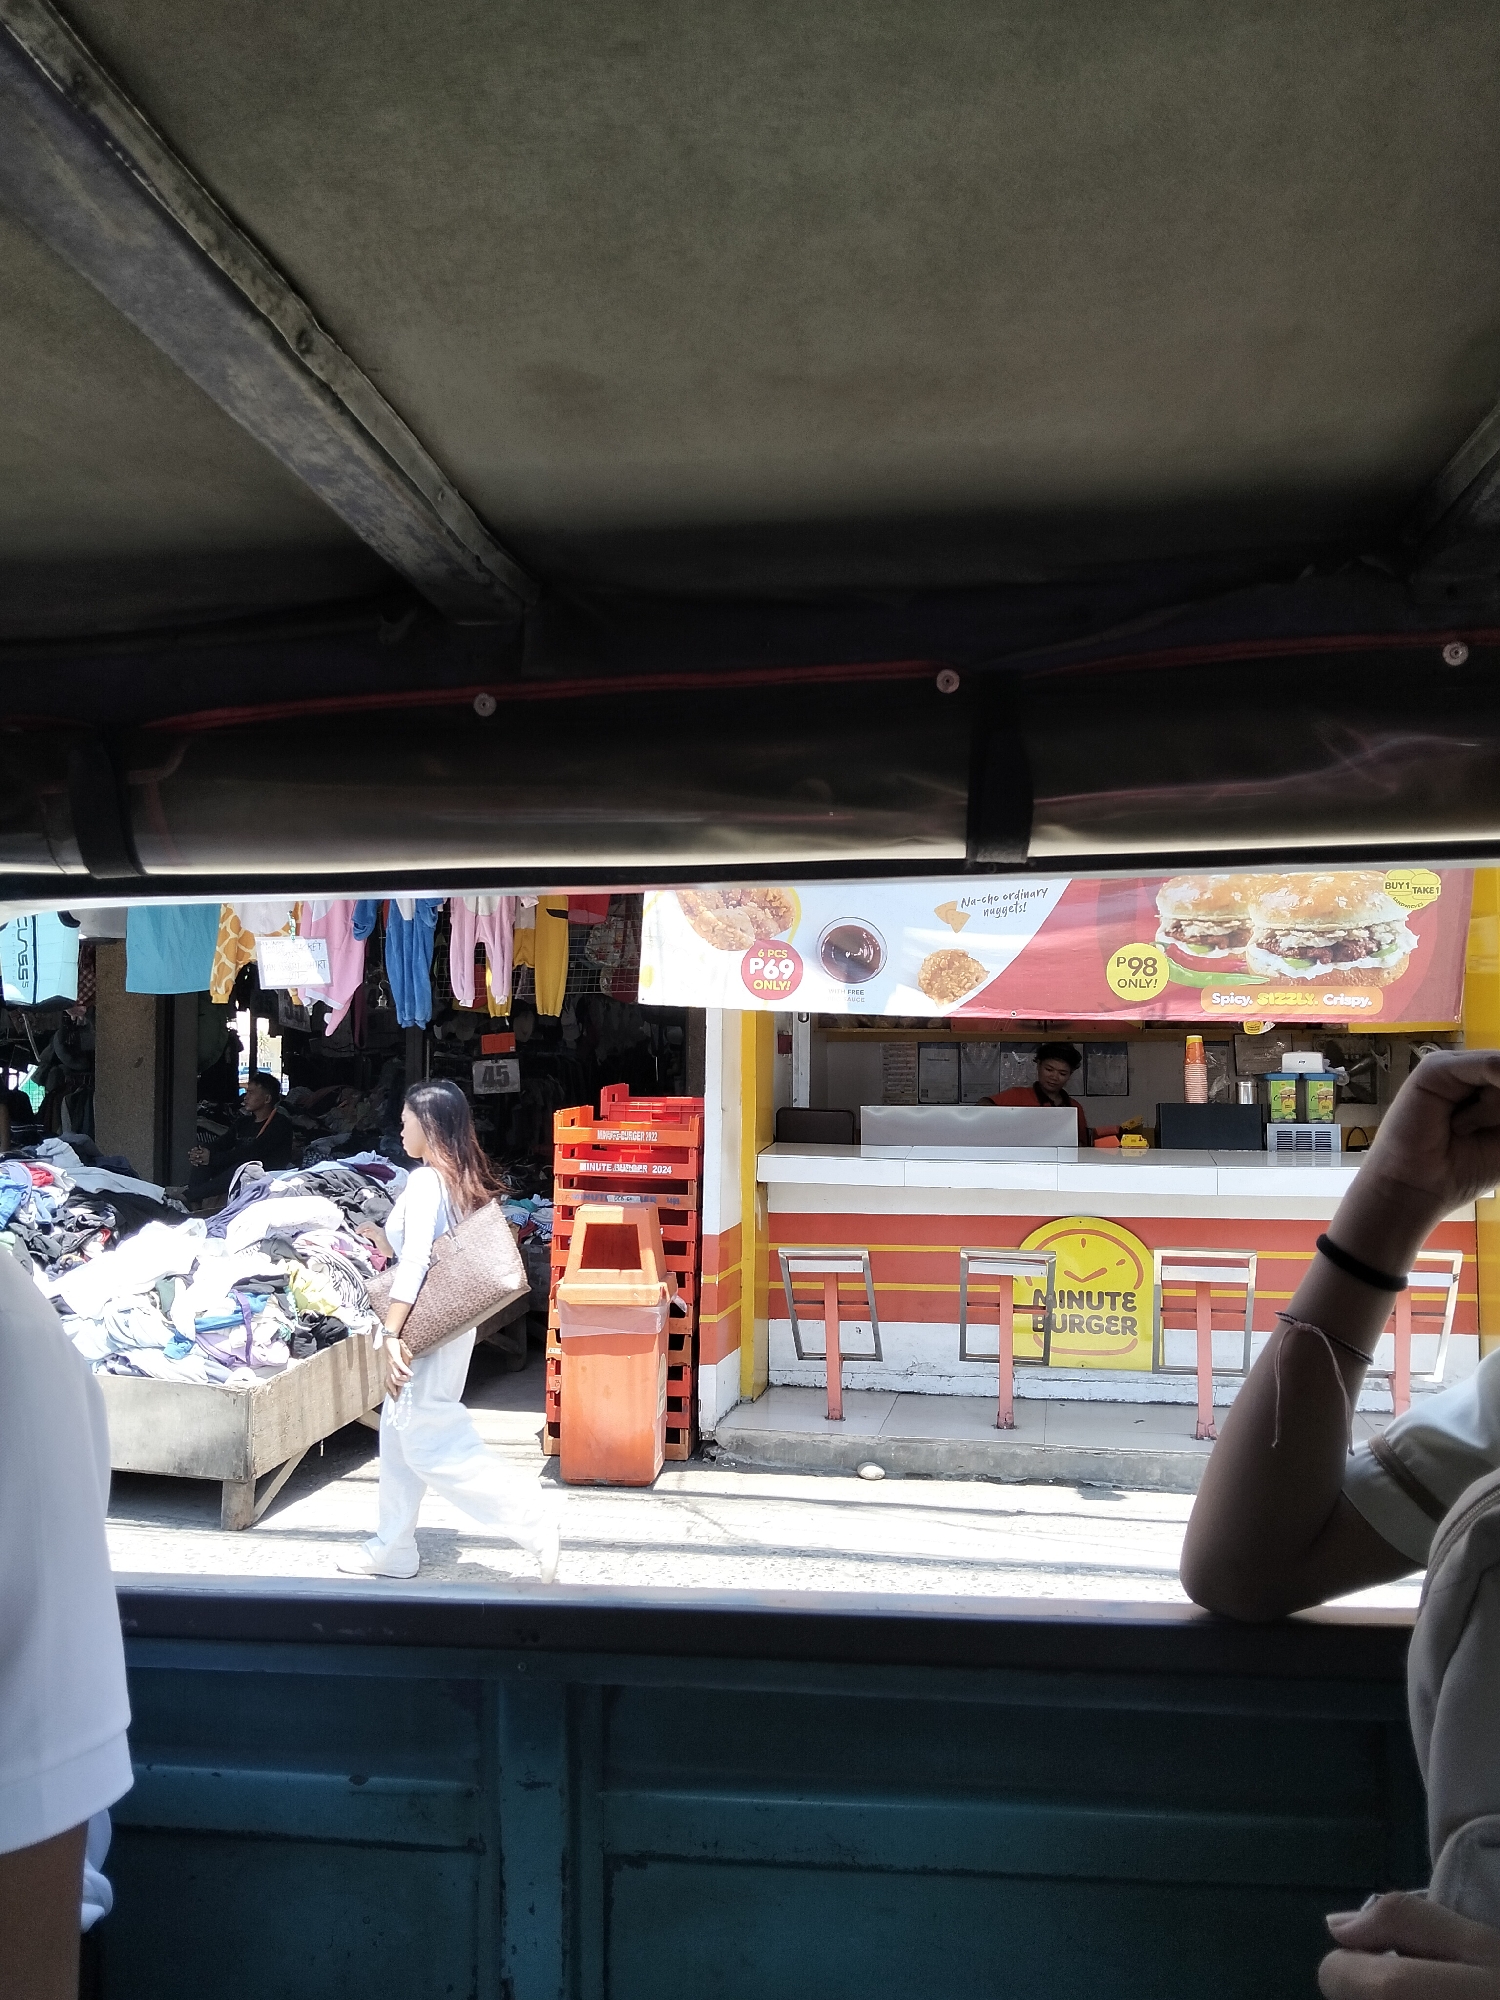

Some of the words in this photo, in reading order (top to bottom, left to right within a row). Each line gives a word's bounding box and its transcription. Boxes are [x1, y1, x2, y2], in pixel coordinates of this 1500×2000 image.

[960, 893, 999, 909] Na-cho
[1002, 887, 1048, 901] ordinary
[1412, 886, 1434, 894] TAKE
[983, 901, 1027, 918] nuggets!
[757, 949, 764, 958] 6
[767, 949, 788, 958] PCS
[753, 979, 792, 991] ONLY!
[1117, 978, 1158, 988] ONLY!
[1211, 992, 1254, 1007] Spicy.
[1256, 992, 1319, 1006] SIZZLY.
[1322, 993, 1373, 1008] Crispy.
[482, 1065, 510, 1087] 45
[579, 1162, 612, 1172] MINUTE
[652, 1165, 673, 1175] 2024
[1032, 1288, 1138, 1312] MINUTE
[1032, 1313, 1138, 1337] BURGER
